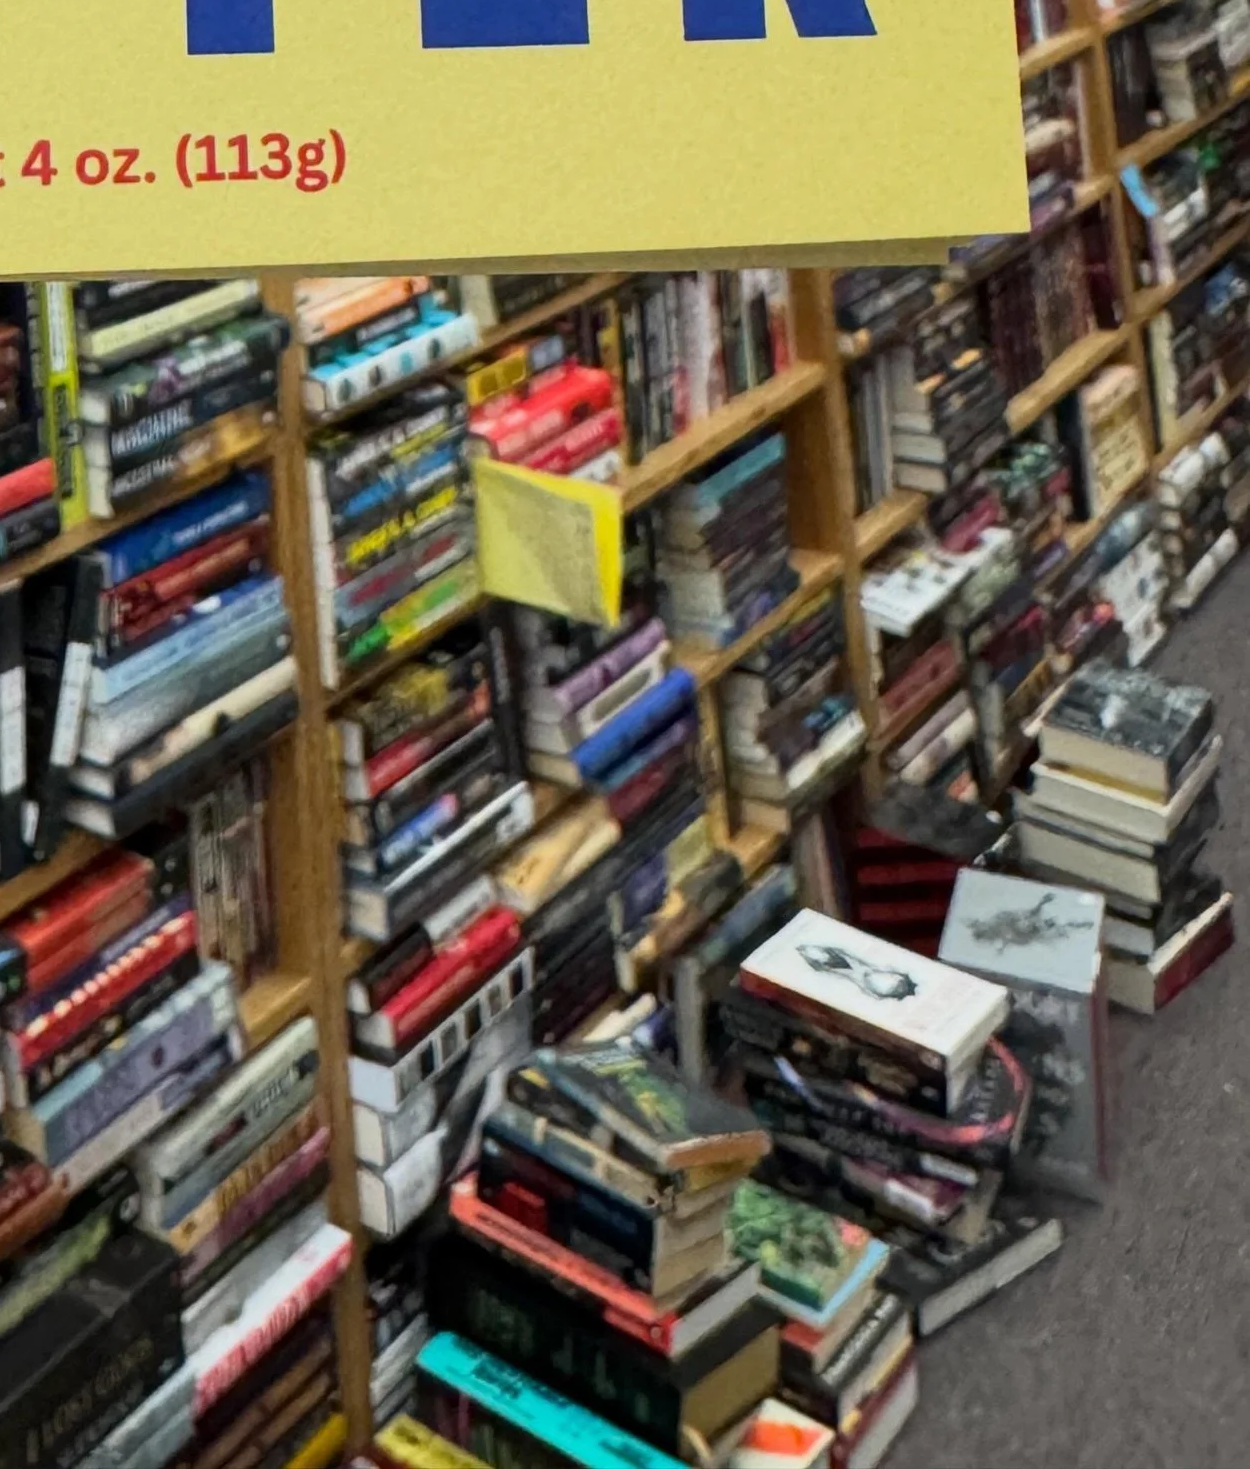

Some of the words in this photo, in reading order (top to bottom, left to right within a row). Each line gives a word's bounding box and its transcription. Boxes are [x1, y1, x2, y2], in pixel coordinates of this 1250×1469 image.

[21, 140, 57, 186] 4
[75, 148, 155, 186] oz.
[176, 130, 346, 193] (113g)
